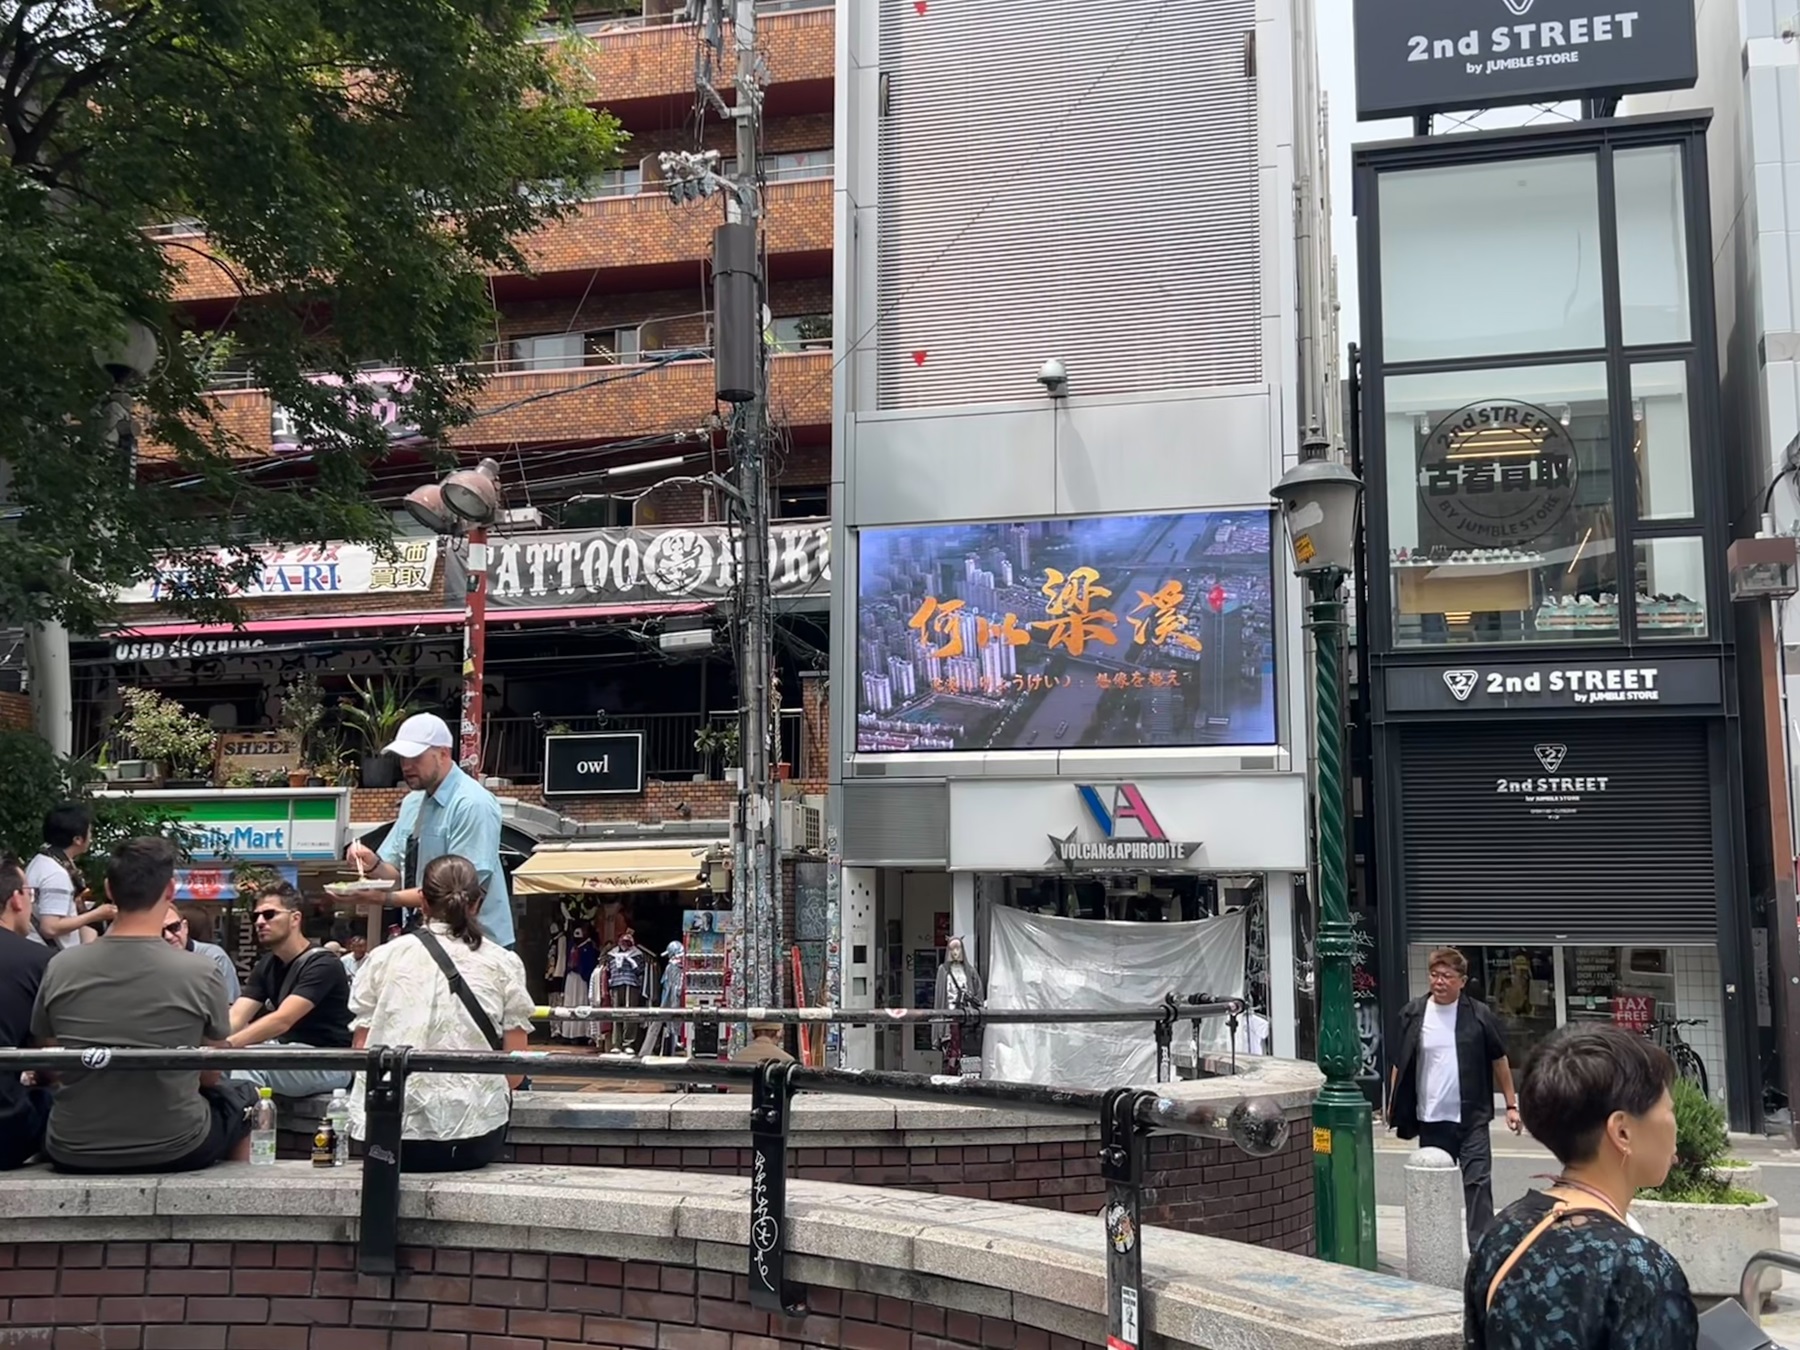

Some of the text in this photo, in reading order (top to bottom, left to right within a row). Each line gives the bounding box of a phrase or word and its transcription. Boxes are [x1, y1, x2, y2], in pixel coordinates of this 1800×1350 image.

[1407, 12, 1639, 62] 2nd STREET
[1466, 51, 1579, 75] by JUMBLE STORE
[1438, 406, 1559, 449] 2nd STREET
[1438, 495, 1562, 537] BY JUMBLE STORE
[369, 566, 427, 589] 買取
[486, 537, 639, 597] ATTOO
[115, 643, 165, 660] USED
[1487, 672, 1541, 692] 2nd
[1549, 669, 1658, 690] STREET
[1574, 691, 1659, 703] by JUMBLE STORE
[577, 754, 610, 774] owl
[1497, 777, 1608, 792] 2nd STREET
[1061, 842, 1185, 860] VOLCAN&APHRODITE
[1616, 997, 1648, 1010] TAX
[1617, 1011, 1648, 1021] FREE
